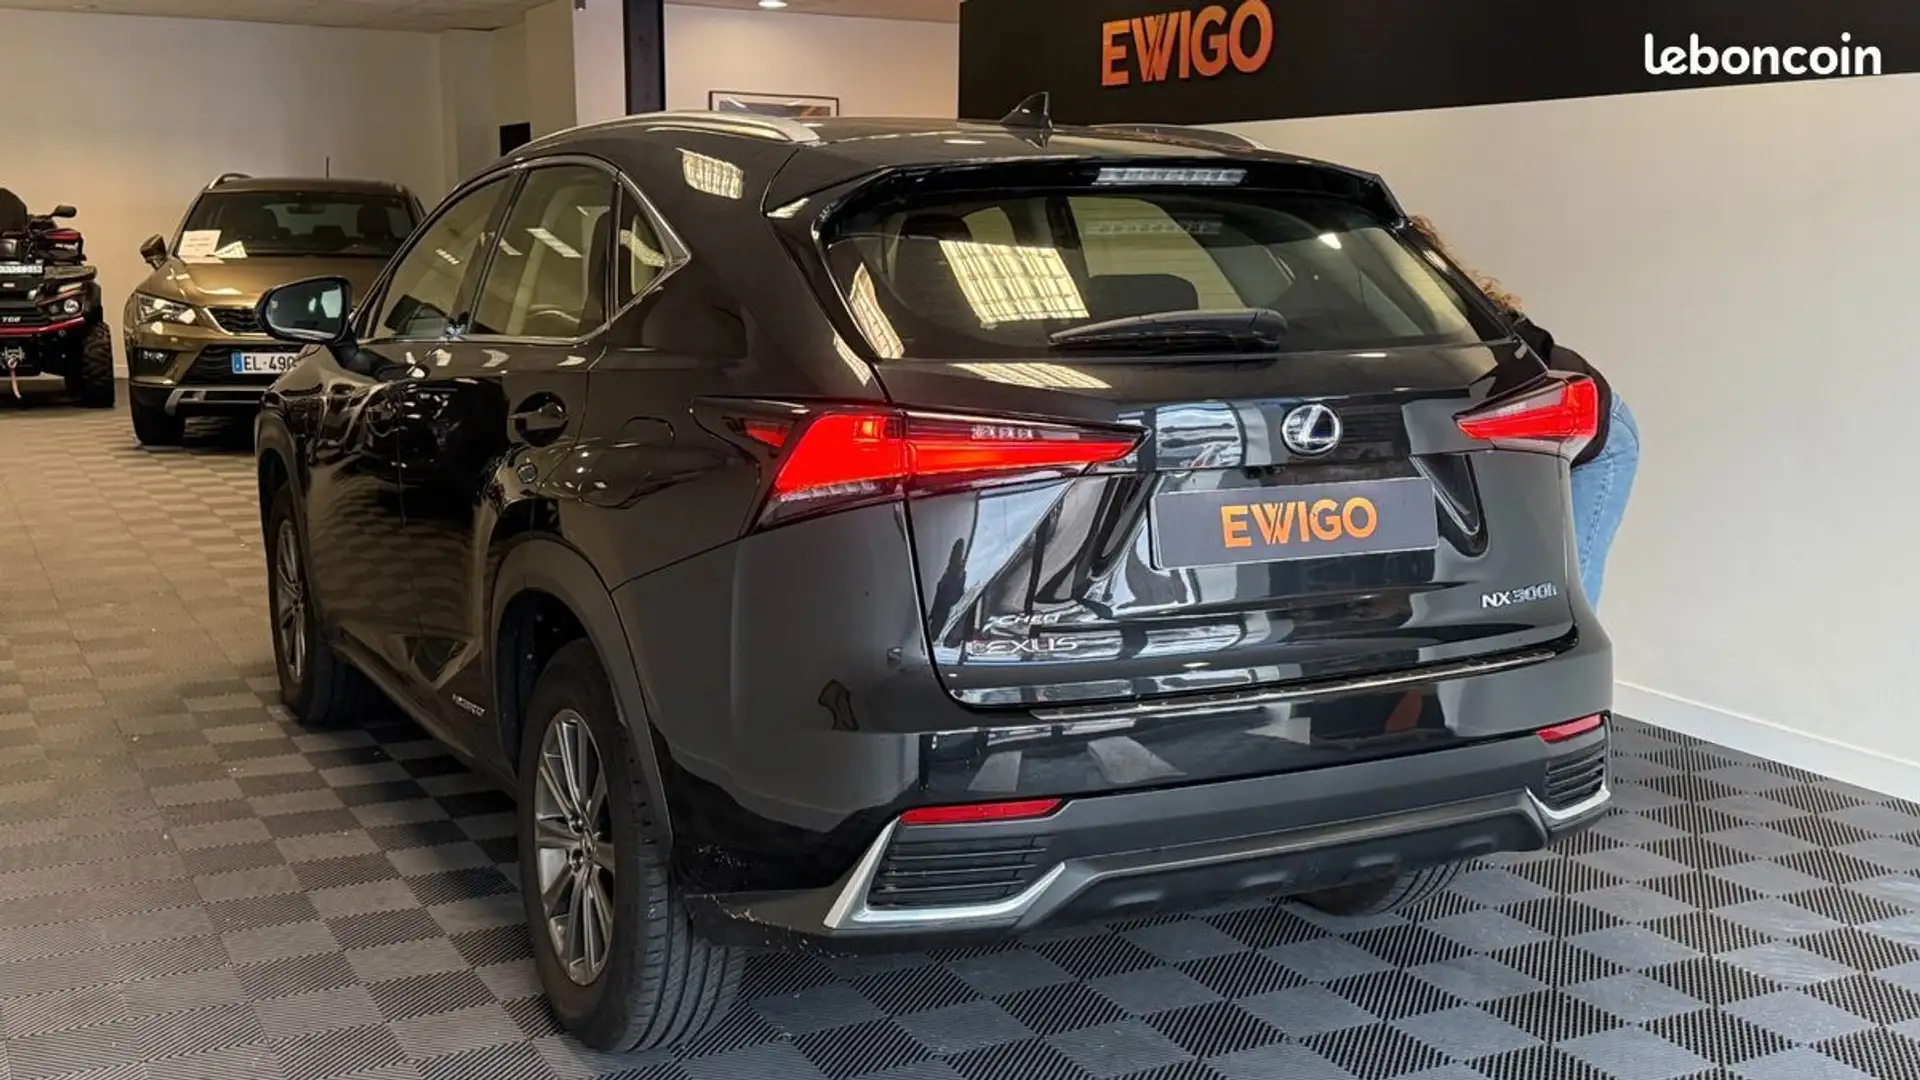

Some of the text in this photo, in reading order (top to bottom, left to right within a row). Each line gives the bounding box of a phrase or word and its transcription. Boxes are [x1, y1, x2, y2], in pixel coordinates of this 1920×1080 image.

[1101, 0, 1274, 87] EWIGO
[1221, 496, 1378, 549] EWIGO
[966, 636, 1078, 656] LEXUS
